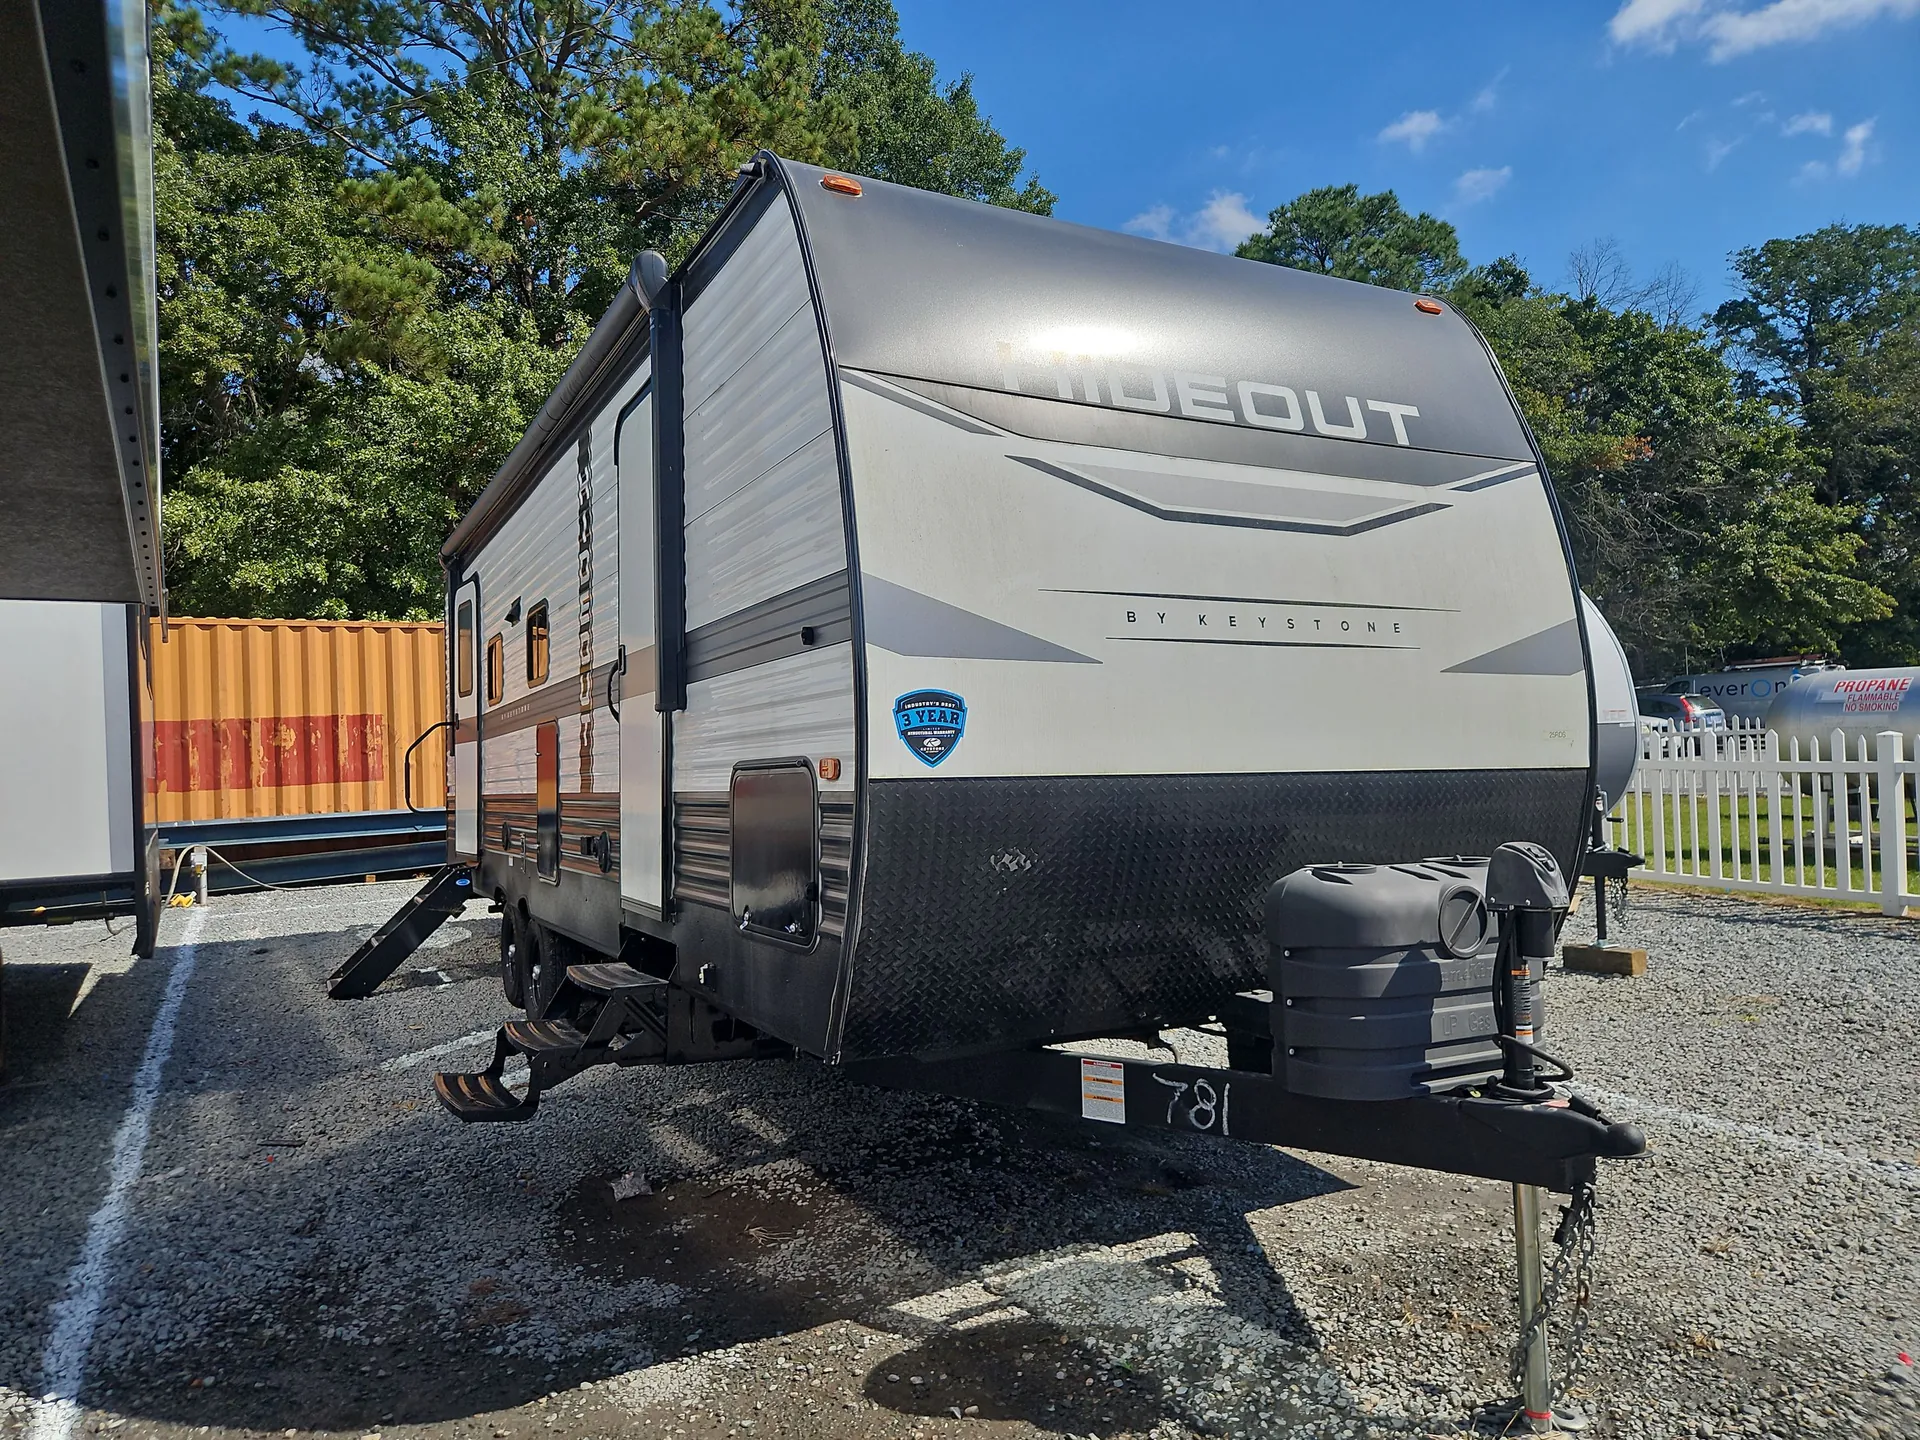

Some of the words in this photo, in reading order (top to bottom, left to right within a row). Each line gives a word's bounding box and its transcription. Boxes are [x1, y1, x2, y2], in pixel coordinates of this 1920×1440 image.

[997, 340, 1420, 446] HIDEOUT
[578, 466, 591, 747] HIDEOUT
[1126, 610, 1166, 624] BY
[1198, 614, 1401, 634] KEYSTONE
[1834, 677, 1912, 693] PROPANE
[1847, 692, 1900, 702] FLAMMABLE
[902, 713, 911, 726] 3
[915, 709, 960, 725] YEAR
[1844, 703, 1857, 712] NO
[1858, 702, 1898, 712] SMOKING
[1443, 1014, 1458, 1036] LP
[1468, 1011, 1492, 1033] Gas
[1152, 1072, 1230, 1135] 781
